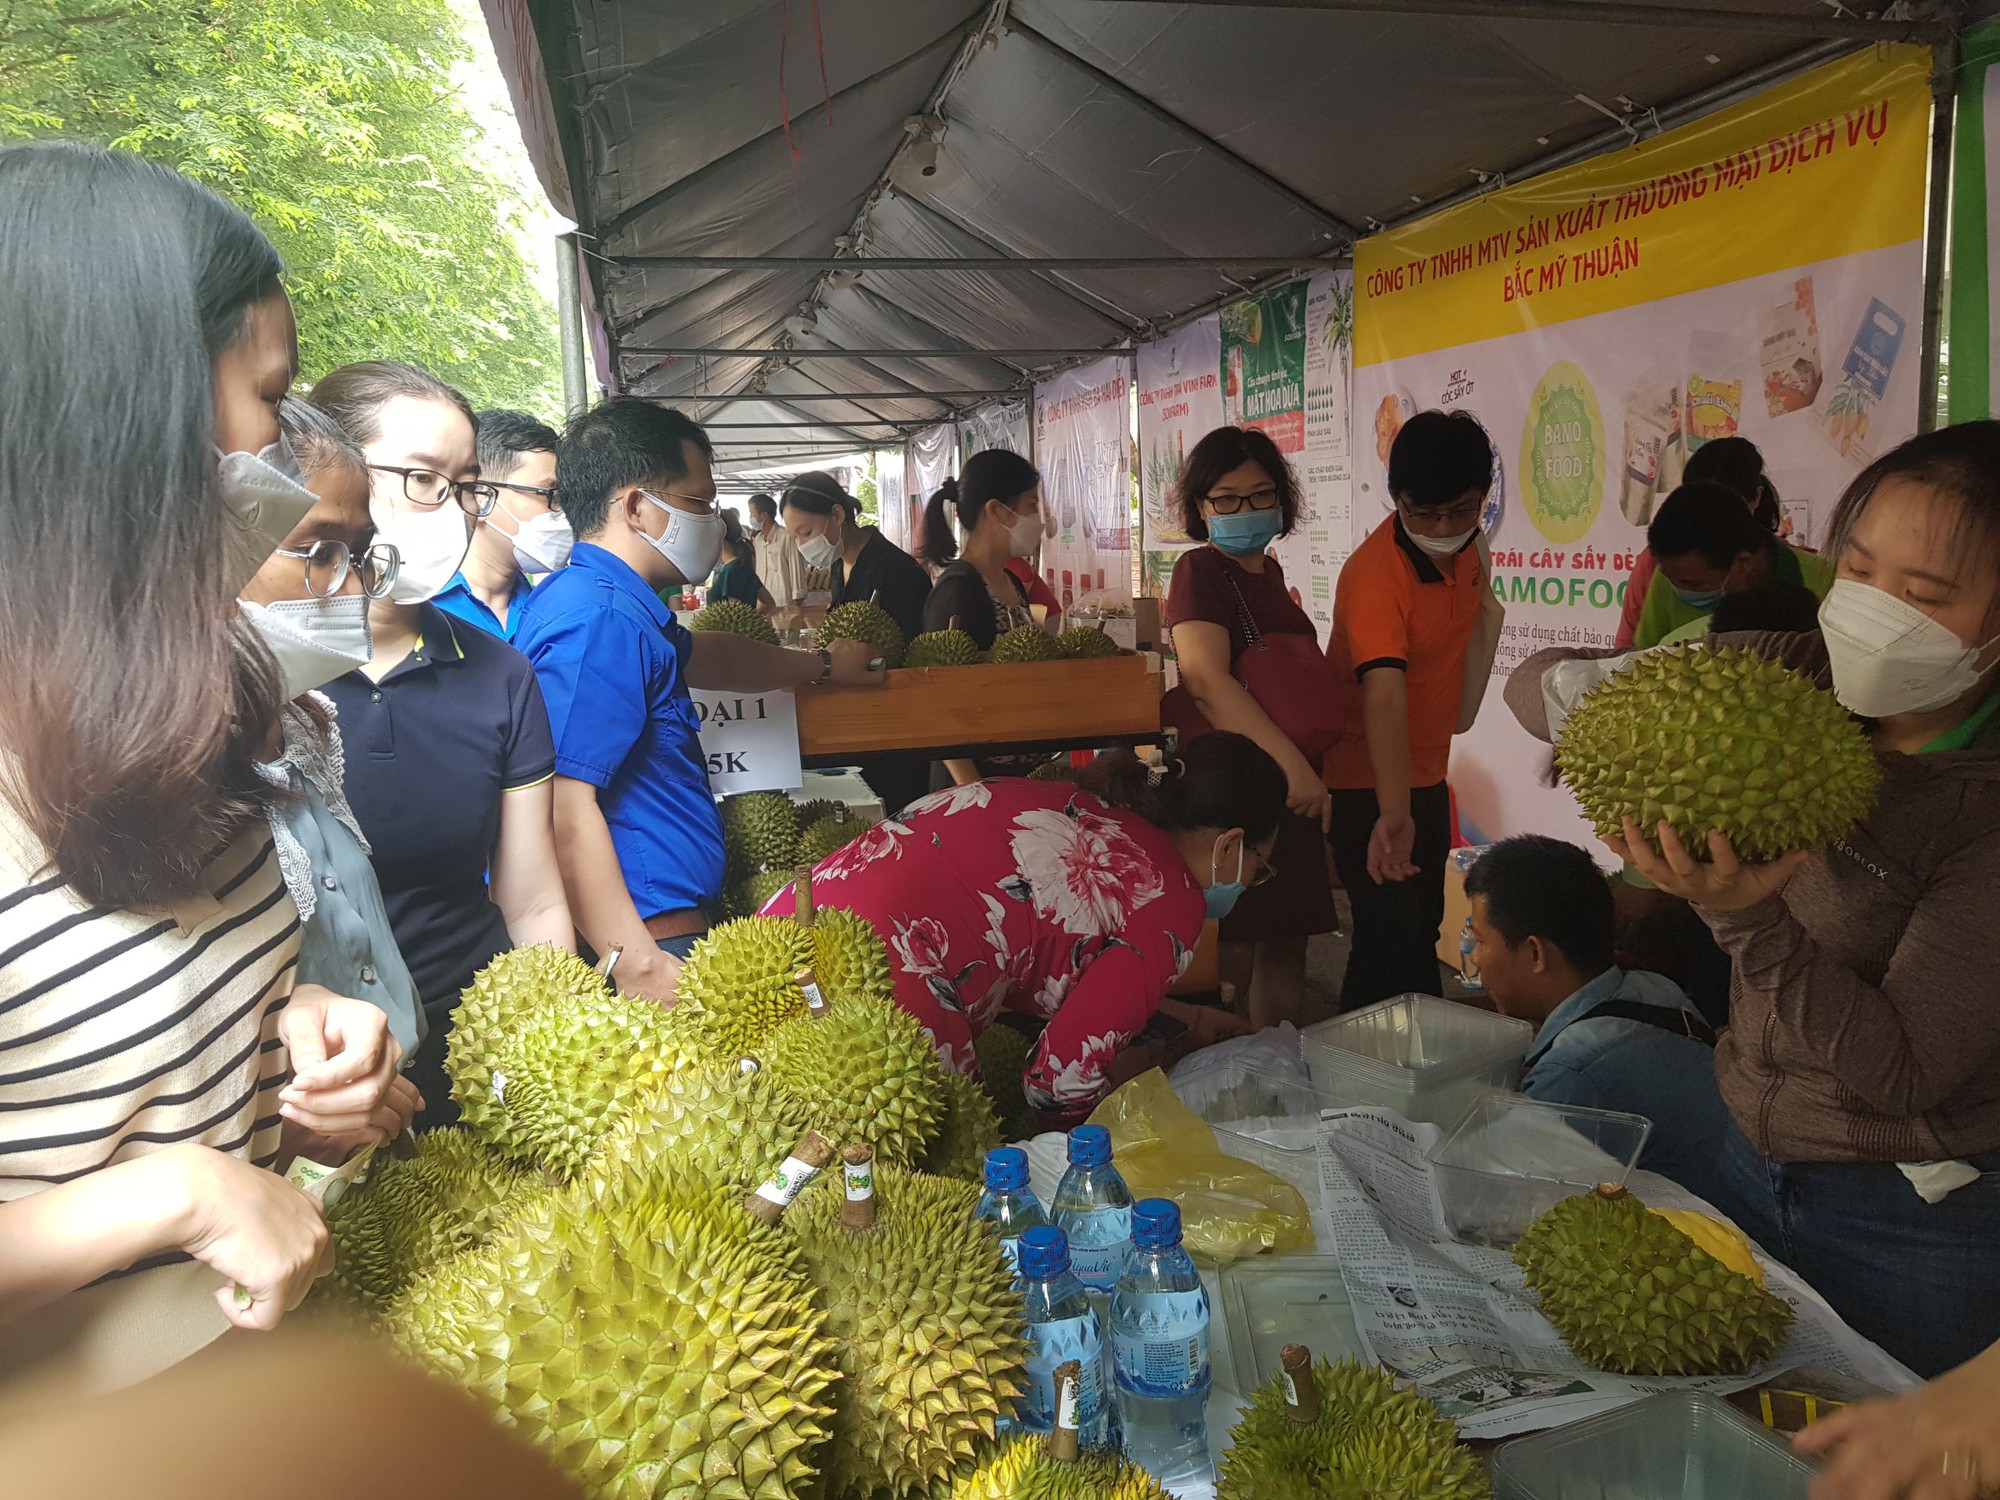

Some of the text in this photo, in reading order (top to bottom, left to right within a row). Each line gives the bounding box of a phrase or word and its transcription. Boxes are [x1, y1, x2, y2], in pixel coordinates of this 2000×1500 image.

[1367, 267, 1403, 298] CÔNG
[1408, 259, 1427, 287] TY
[1430, 244, 1473, 280] TNHH
[1478, 231, 1511, 266] MTV
[1515, 215, 1549, 254] SẢN
[1555, 192, 1609, 242] XUẤT
[1714, 145, 1761, 190] MẠI
[1768, 119, 1835, 174] DỊCH
[1844, 100, 1888, 147] VỤ
[1503, 236, 1639, 303] BẮC MỸ THUẬN
[1450, 369, 1462, 382] HOT
[1265, 387, 1281, 412] HOA
[1282, 379, 1300, 408] DỪA
[1544, 421, 1582, 446] BAMO
[1545, 456, 1583, 480] FOOD
[1490, 548, 1523, 567] TRÁI
[1529, 548, 1565, 569] CÂY
[1571, 545, 1606, 571] SẤY
[1518, 622, 1530, 637] sử
[1531, 623, 1555, 644] dụng
[1557, 625, 1582, 642] chất
[1583, 627, 1603, 644] bảo
[755, 697, 769, 720] 1
[703, 751, 751, 775] 5K
